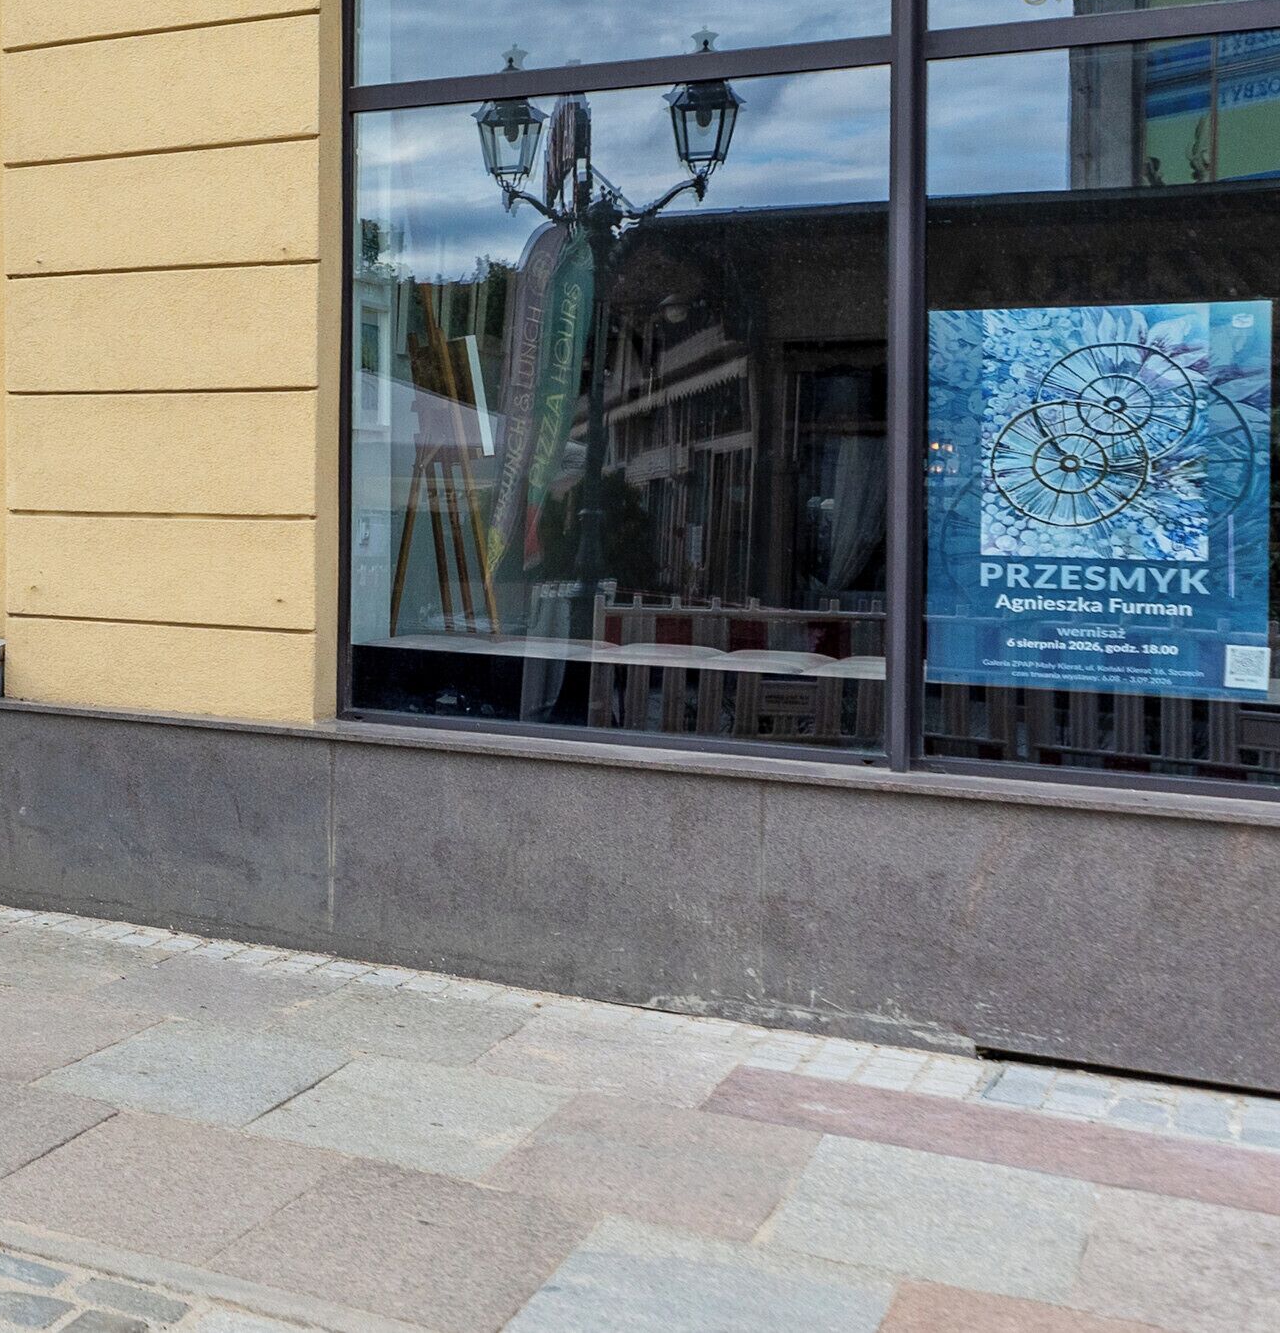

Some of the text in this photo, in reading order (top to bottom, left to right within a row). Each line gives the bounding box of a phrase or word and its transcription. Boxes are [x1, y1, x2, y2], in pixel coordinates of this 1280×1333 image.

[980, 562, 1210, 595] PRZESMYK
[995, 594, 1193, 617] Agnieszka Furman
[1057, 627, 1126, 640] wernisaż
[1006, 638, 1016, 648] 6
[1018, 638, 1066, 651] sierpnia
[1105, 643, 1139, 654] godz.
[1142, 644, 1179, 656] 18.00
